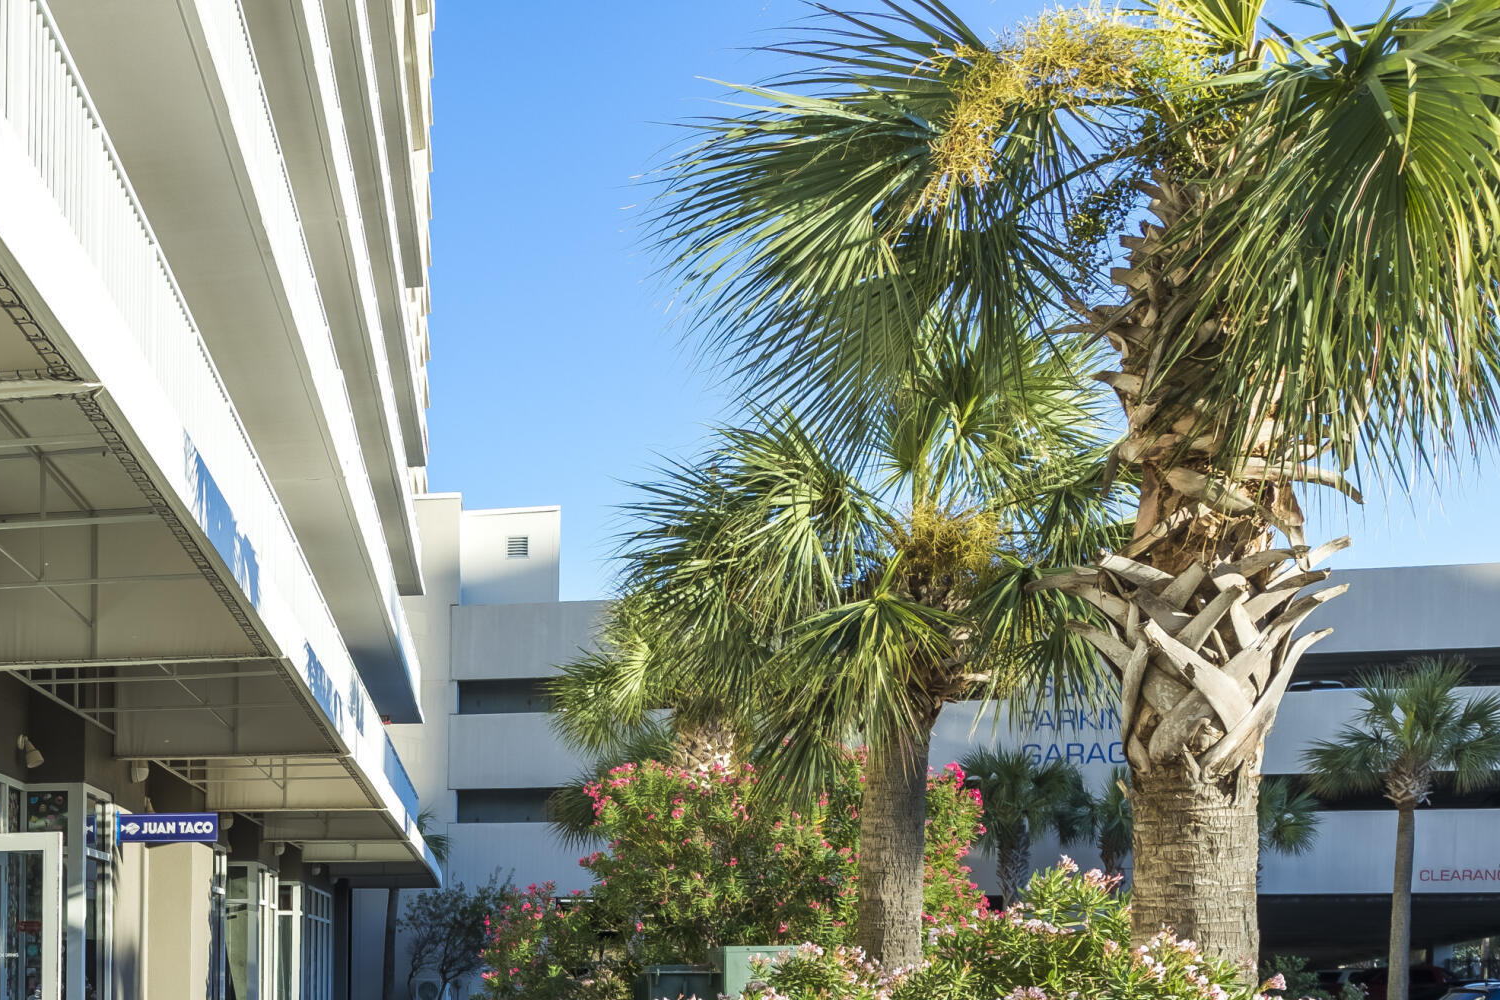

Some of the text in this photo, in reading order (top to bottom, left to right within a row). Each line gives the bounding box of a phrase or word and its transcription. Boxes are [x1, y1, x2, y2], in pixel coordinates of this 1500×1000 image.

[1020, 708, 1122, 732] PARKIN
[1022, 742, 1127, 765] GARAG
[142, 821, 213, 834] JUAN TACO
[1420, 868, 1500, 882] CLEARAN
